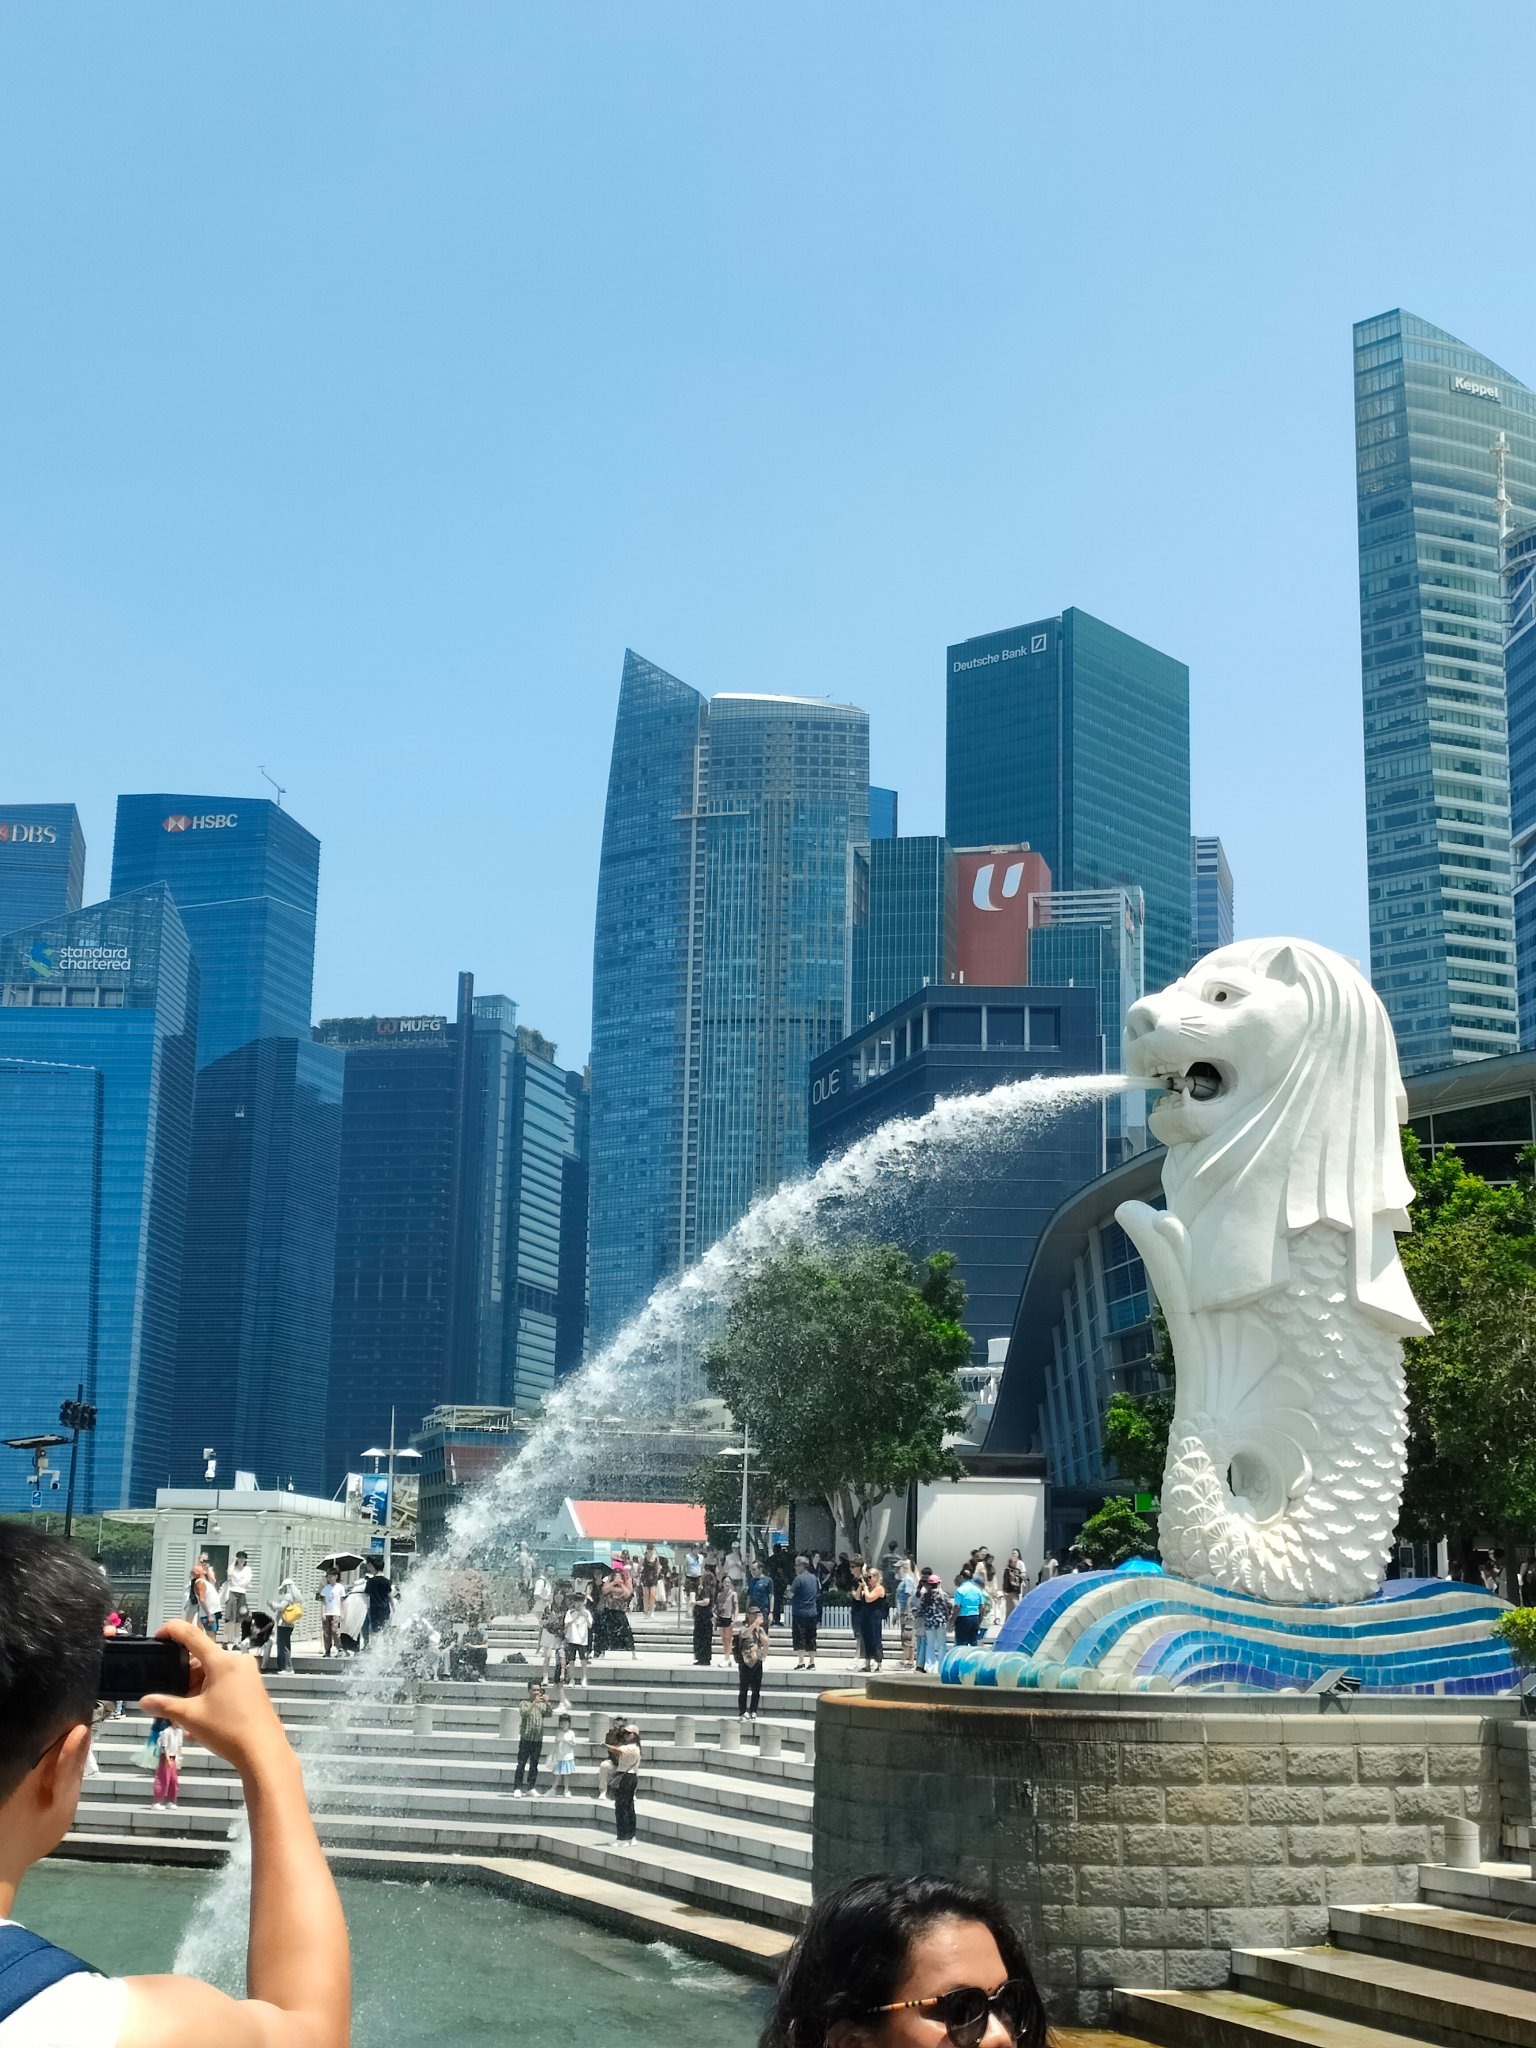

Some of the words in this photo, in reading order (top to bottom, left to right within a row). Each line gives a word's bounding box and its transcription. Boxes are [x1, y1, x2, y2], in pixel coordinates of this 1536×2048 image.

[1455, 376, 1498, 398] Keppel
[953, 653, 1000, 673] Deutsche
[1002, 646, 1027, 661] Bank
[192, 814, 238, 829] HSBC
[11, 825, 57, 844] DBS
[59, 946, 128, 959] standard
[59, 958, 131, 971] chartered
[400, 1019, 441, 1032] MUFG
[812, 1069, 840, 1105] OUE
